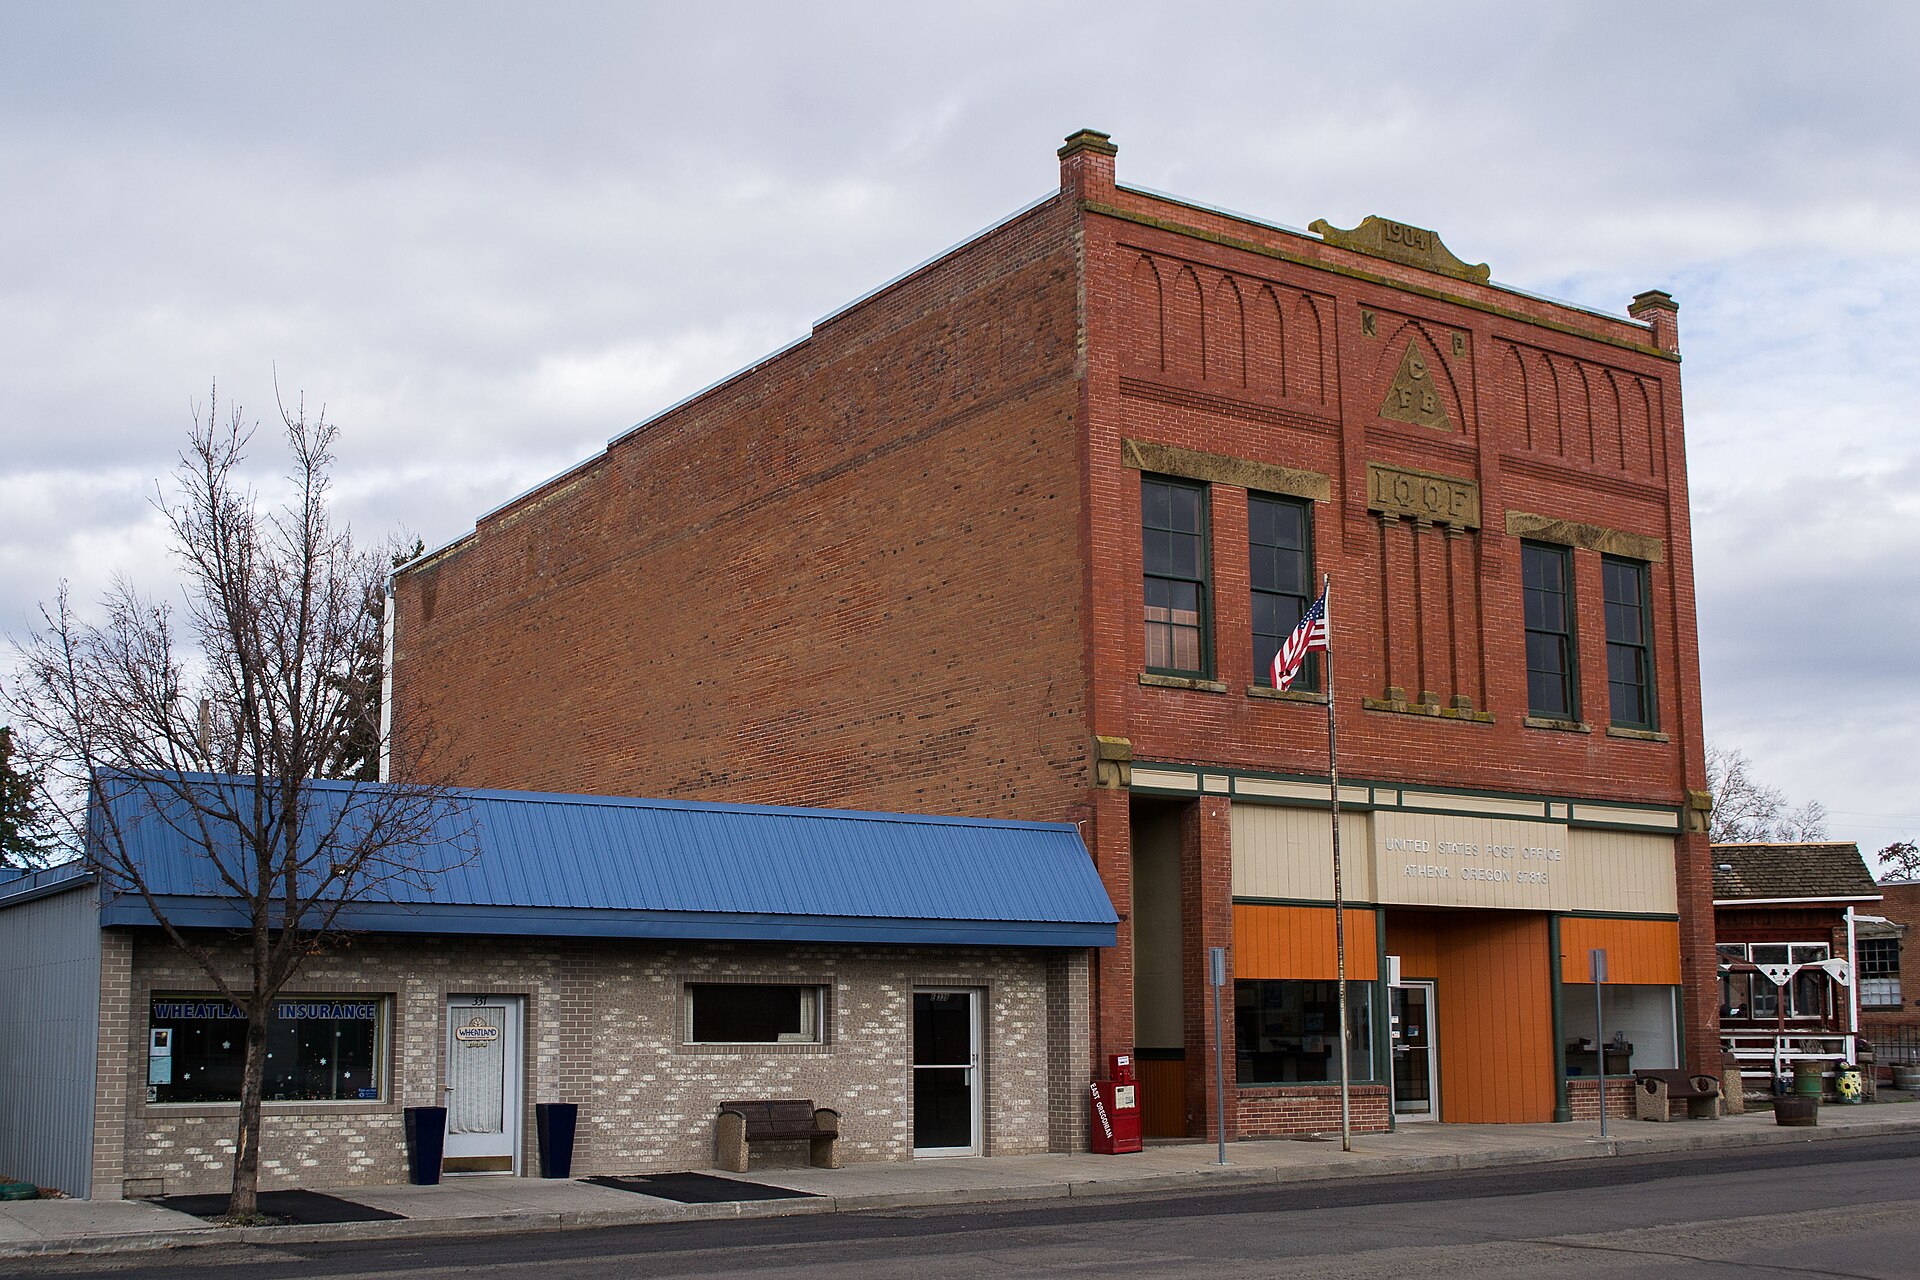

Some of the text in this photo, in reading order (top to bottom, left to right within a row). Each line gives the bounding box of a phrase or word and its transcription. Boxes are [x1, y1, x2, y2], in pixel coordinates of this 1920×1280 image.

[1384, 220, 1425, 250] 1904
[1361, 309, 1376, 337] K
[1408, 360, 1424, 380] C
[1396, 386, 1412, 408] F
[1376, 470, 1469, 516] IOOF
[1386, 838, 1561, 862] UNITED STATES POST OFFICE
[1461, 867, 1511, 883] OREGON
[1516, 870, 1549, 885] 97813
[155, 1003, 375, 1019] WHEATLA INSURANCE
[459, 1028, 497, 1037] WHEATLAND
[1090, 1083, 1113, 1138] EAST OREGONIAN
